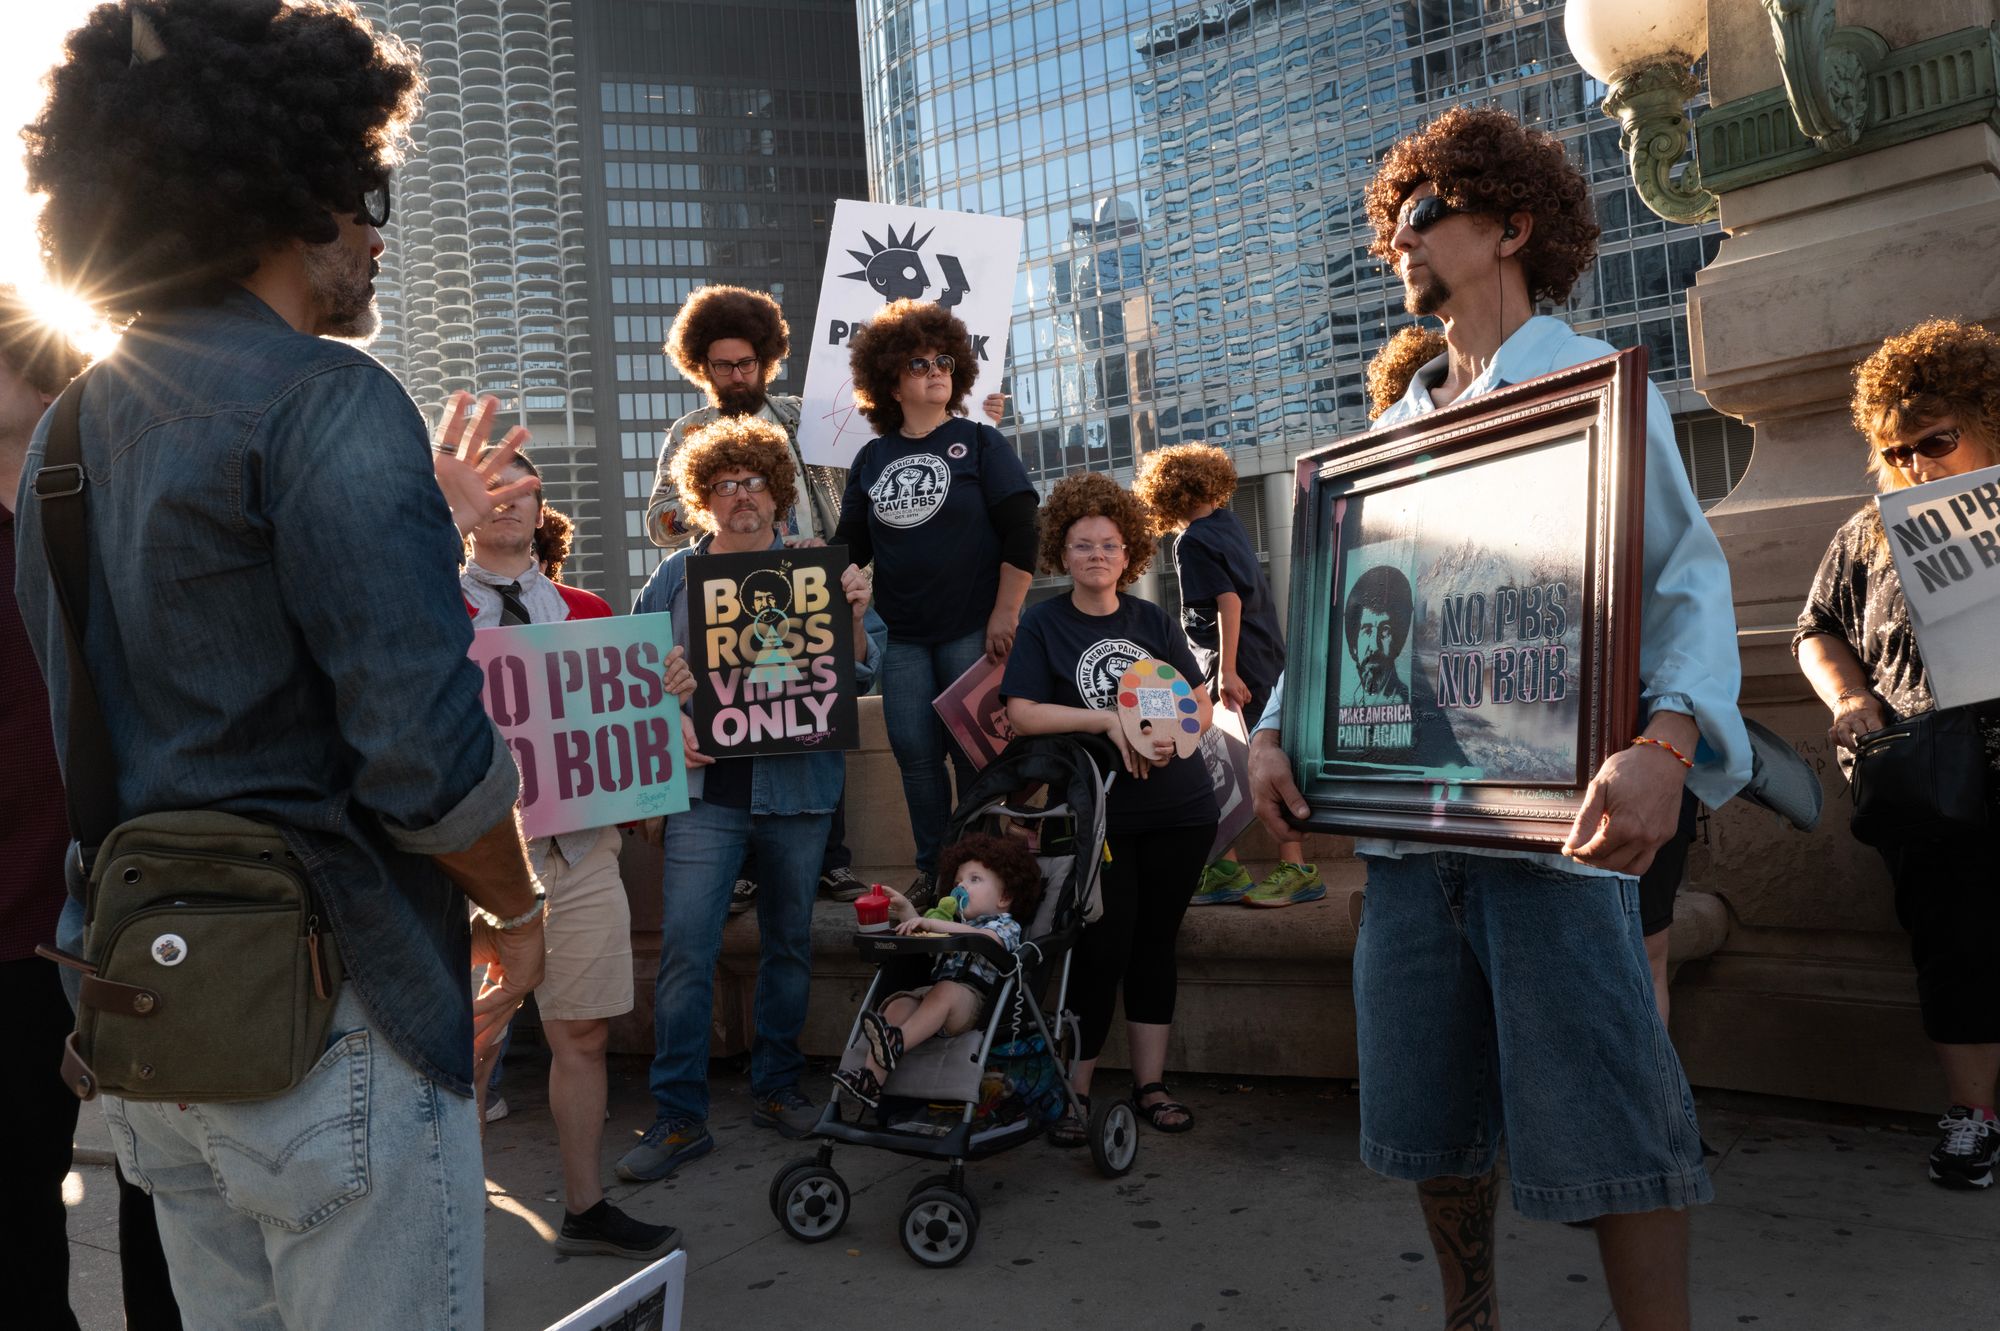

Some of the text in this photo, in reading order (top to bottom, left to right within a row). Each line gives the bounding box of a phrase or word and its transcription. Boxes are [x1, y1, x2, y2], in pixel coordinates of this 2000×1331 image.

[884, 459, 915, 479] AMERICA
[877, 495, 937, 514] SAVE PBS
[1892, 477, 2000, 557] NO PB
[1912, 545, 1973, 594] NO
[706, 613, 835, 670] ROSS
[1440, 582, 1568, 648] NO PBS
[475, 642, 664, 727] O PBS
[1082, 643, 1143, 690] MAKE AMERICA PAINT
[1437, 644, 1567, 709] NO BOB
[711, 692, 839, 747] ONLY
[1337, 722, 1412, 748] PAINT AGAIN
[1338, 704, 1412, 724] MAKE AMERICA
[553, 717, 673, 800] BOB
